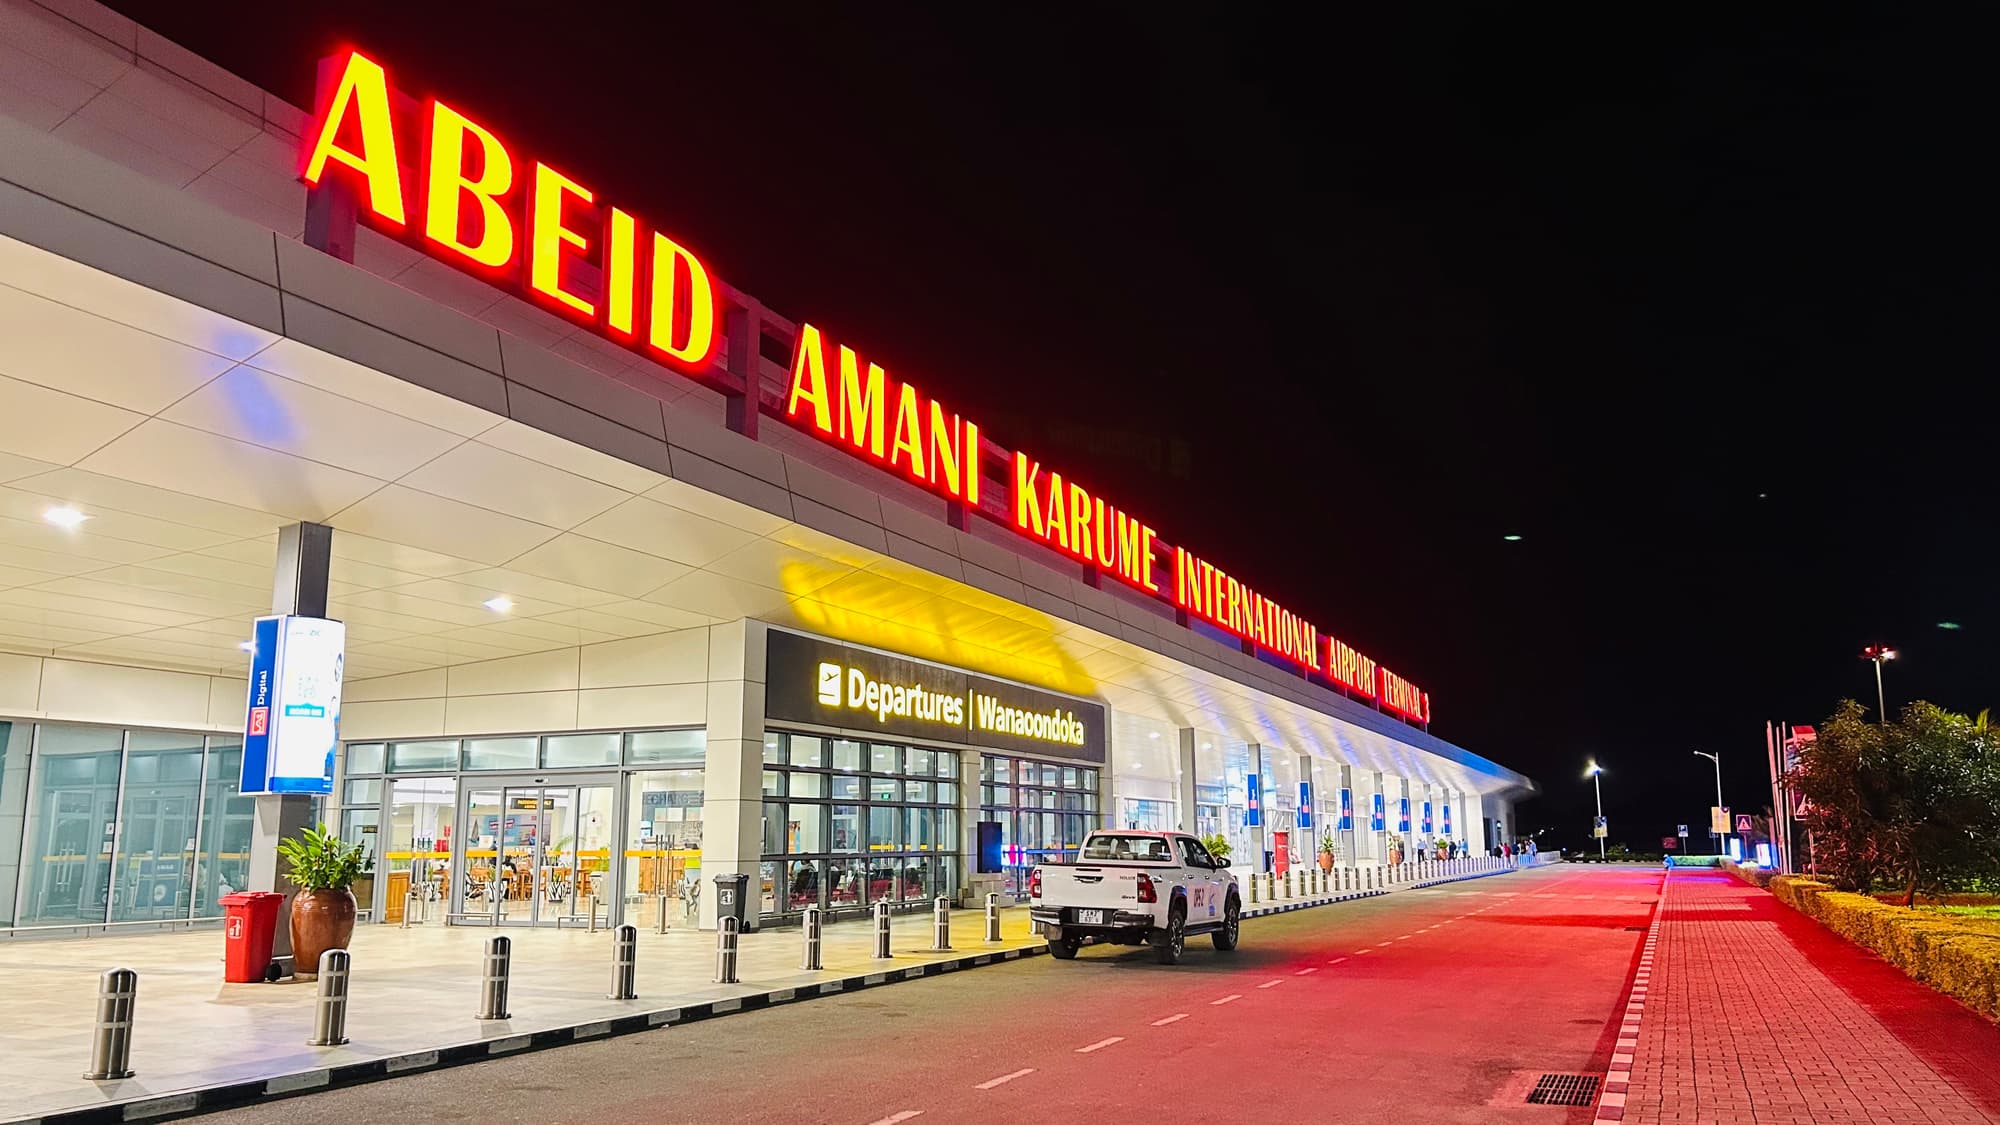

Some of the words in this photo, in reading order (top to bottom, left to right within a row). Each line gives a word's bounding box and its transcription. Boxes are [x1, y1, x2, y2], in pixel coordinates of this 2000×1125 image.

[305, 51, 713, 363] ABEID
[788, 323, 980, 505] AMANI
[1016, 451, 1159, 592] KARUME
[1177, 546, 1321, 671] INTERNATIONAL
[1329, 636, 1377, 698] AIRPORT
[1381, 667, 1423, 720] TERMINAL
[1423, 692, 1430, 723] 3
[257, 670, 268, 706] Digital
[847, 668, 963, 723] Departures
[977, 694, 1086, 745] Wanaoondoka
